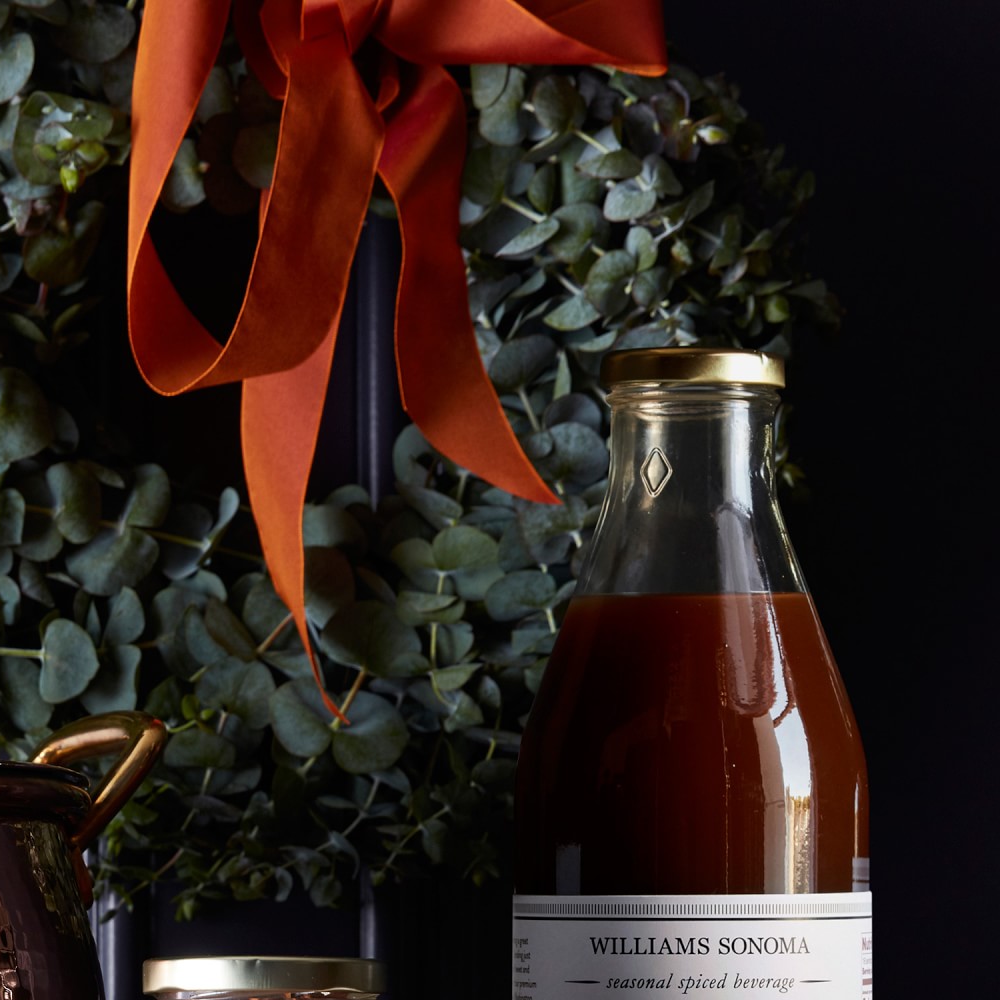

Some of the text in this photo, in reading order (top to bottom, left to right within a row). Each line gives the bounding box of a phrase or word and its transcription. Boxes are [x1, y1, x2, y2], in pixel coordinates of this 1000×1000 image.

[590, 936, 810, 955] WILLIAMS SONOMA
[606, 973, 796, 994] seasonal spiced beverage
